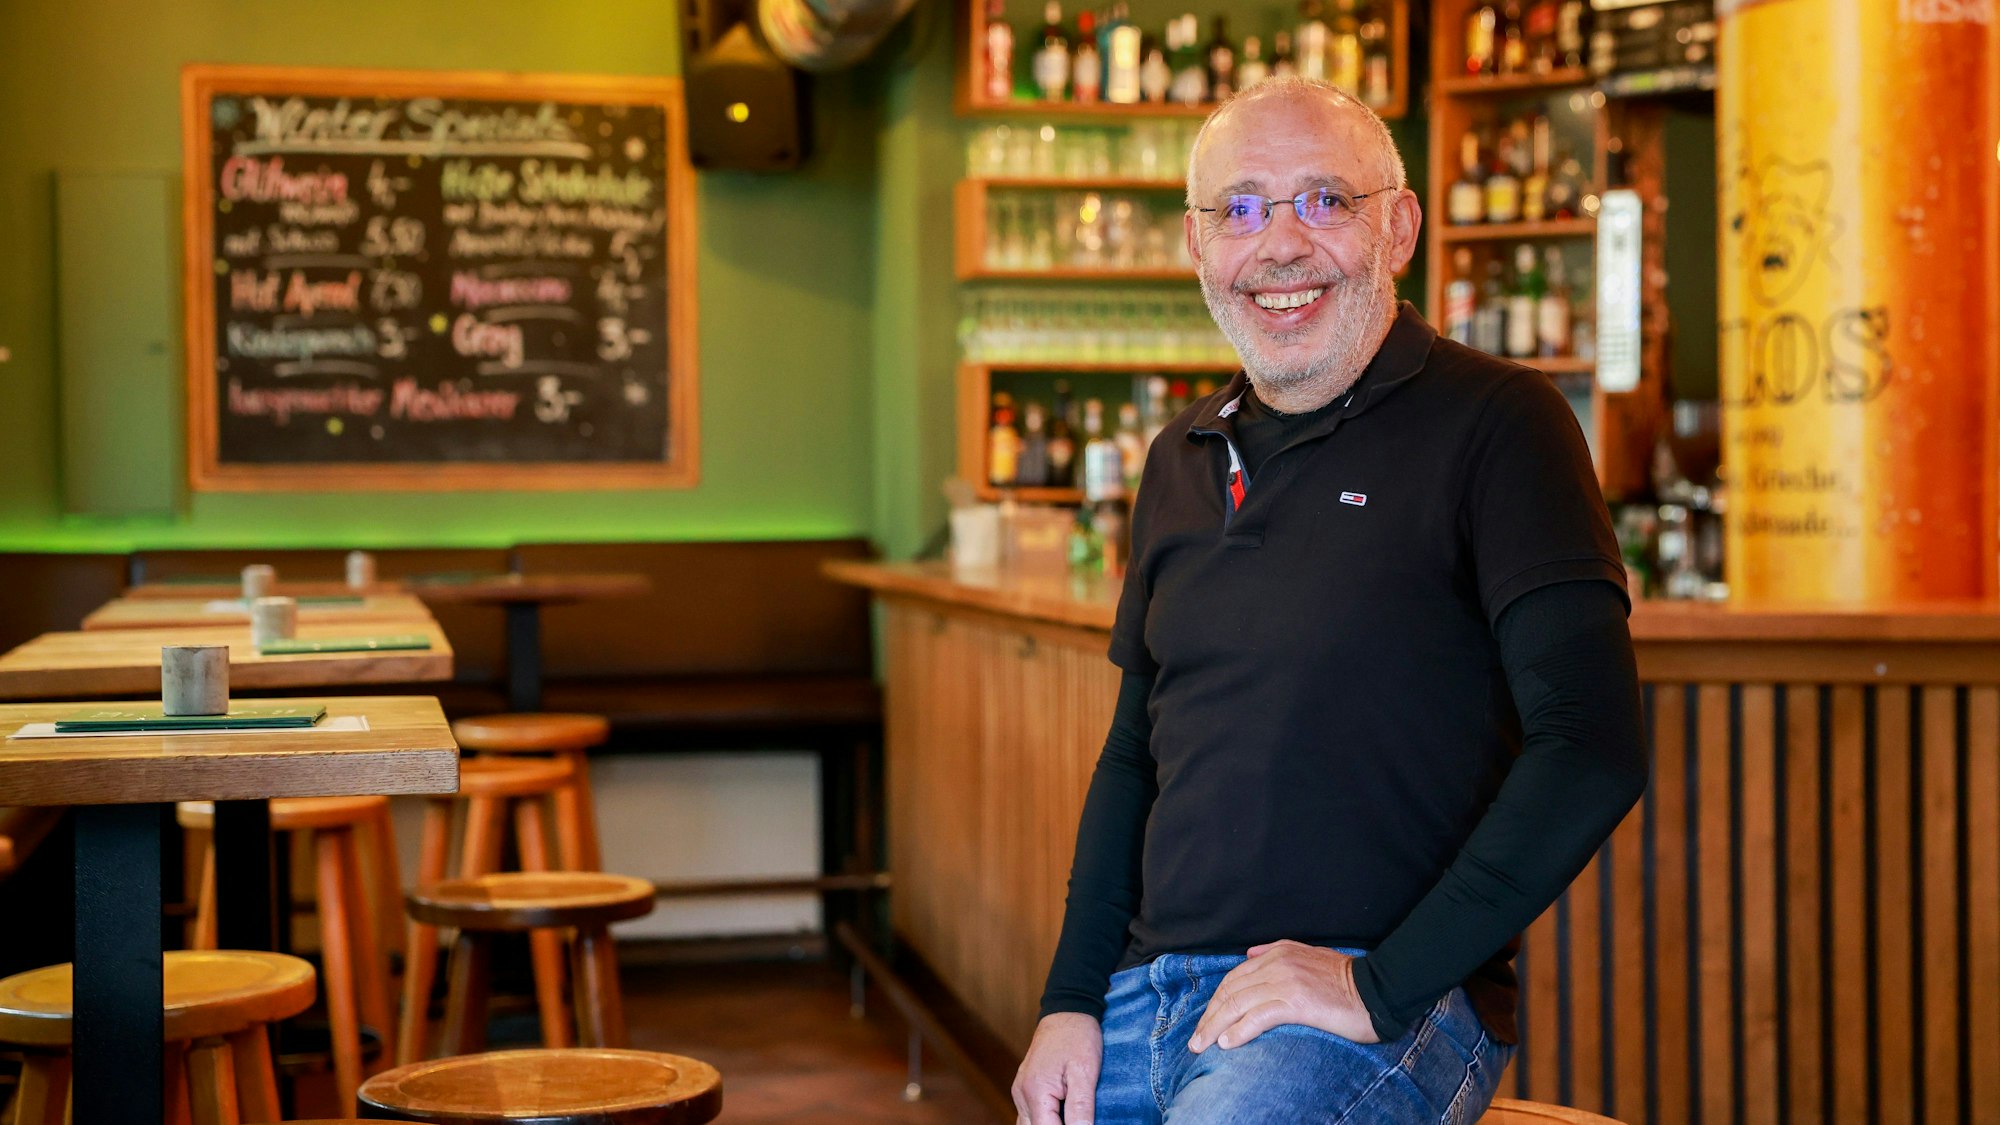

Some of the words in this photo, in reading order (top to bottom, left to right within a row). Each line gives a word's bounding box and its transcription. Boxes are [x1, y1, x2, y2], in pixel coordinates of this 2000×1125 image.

[251, 97, 398, 146] Winter
[404, 98, 582, 156] Specials
[220, 156, 348, 205] Glühwein
[518, 160, 652, 204] Schokolade
[231, 270, 281, 311] Hot
[284, 269, 361, 319] Aperol
[453, 313, 525, 369] Grog
